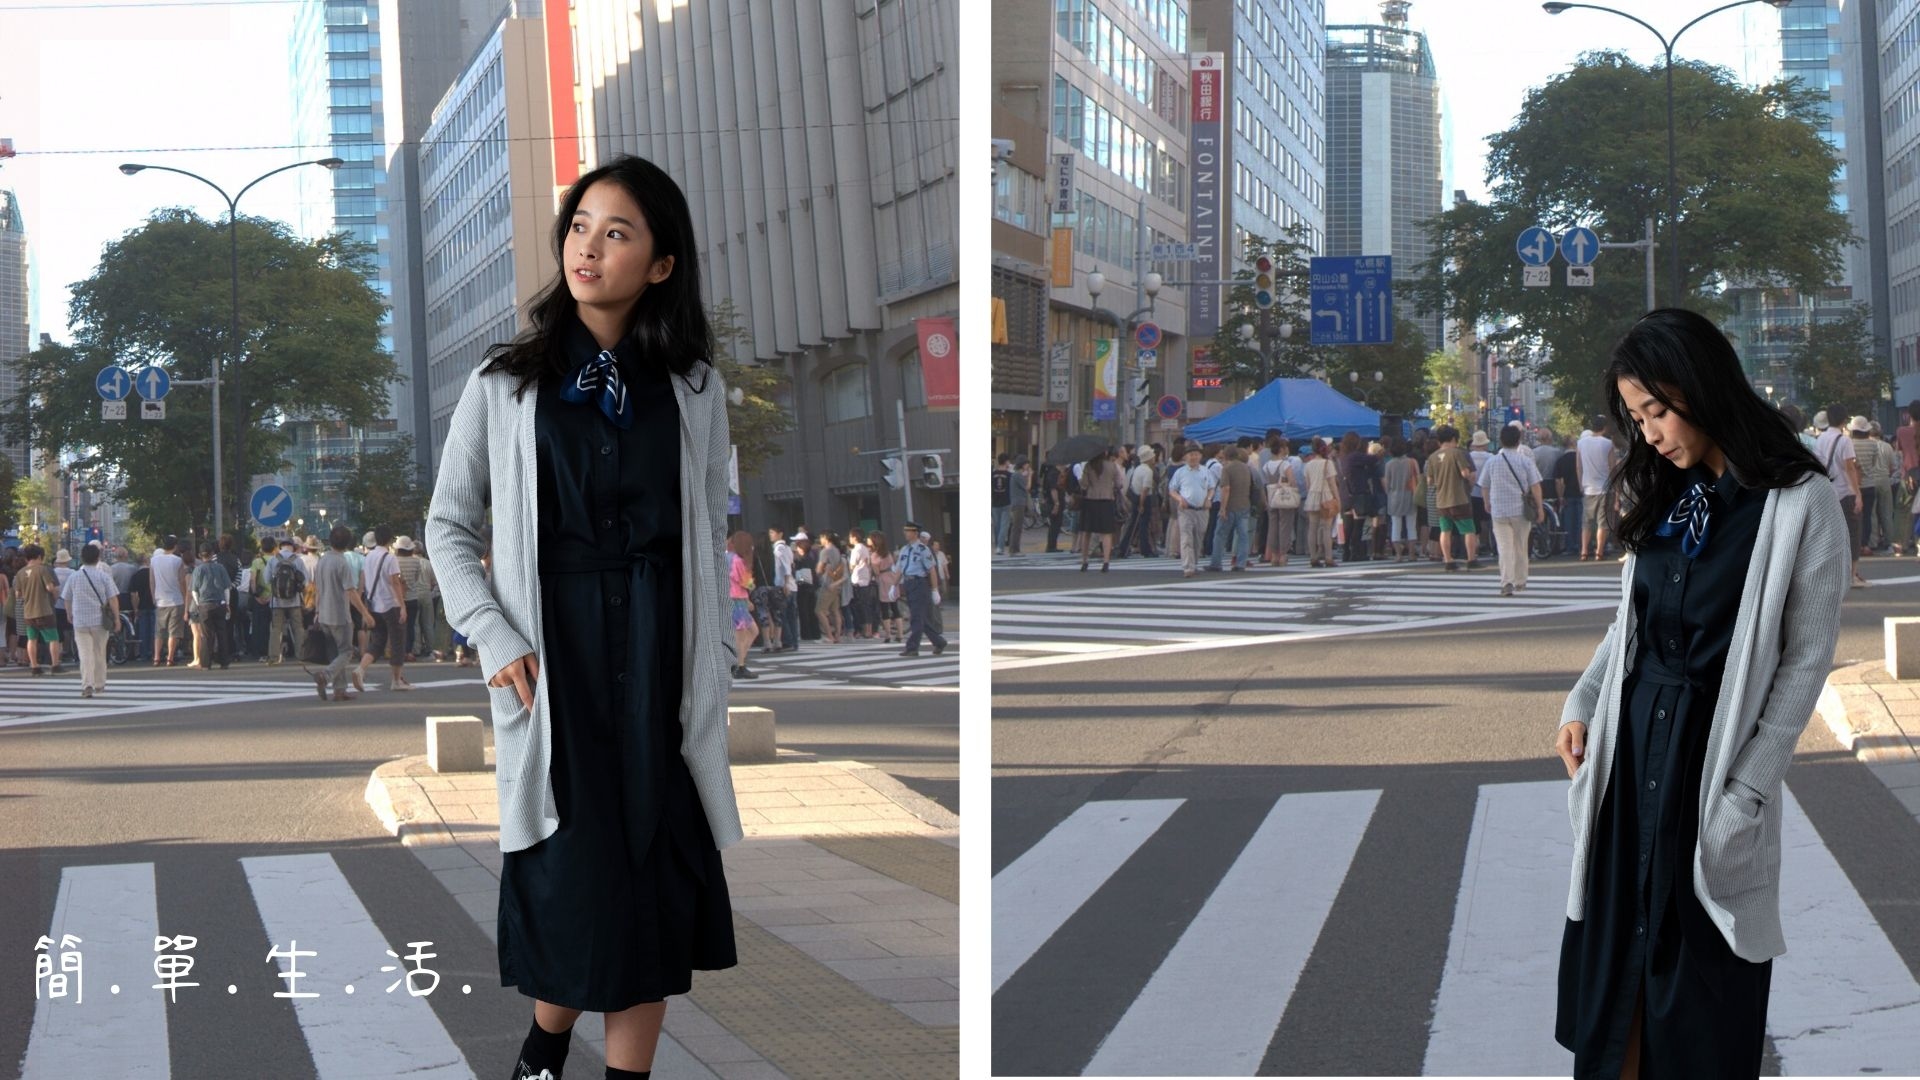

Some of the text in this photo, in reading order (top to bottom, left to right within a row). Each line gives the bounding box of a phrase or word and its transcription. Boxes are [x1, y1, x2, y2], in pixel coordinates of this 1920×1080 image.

[1200, 72, 1212, 120] 秋田銀行
[1197, 138, 1213, 263] FONTAINE
[1524, 270, 1549, 283] 7-22
[103, 405, 126, 416] 7-22
